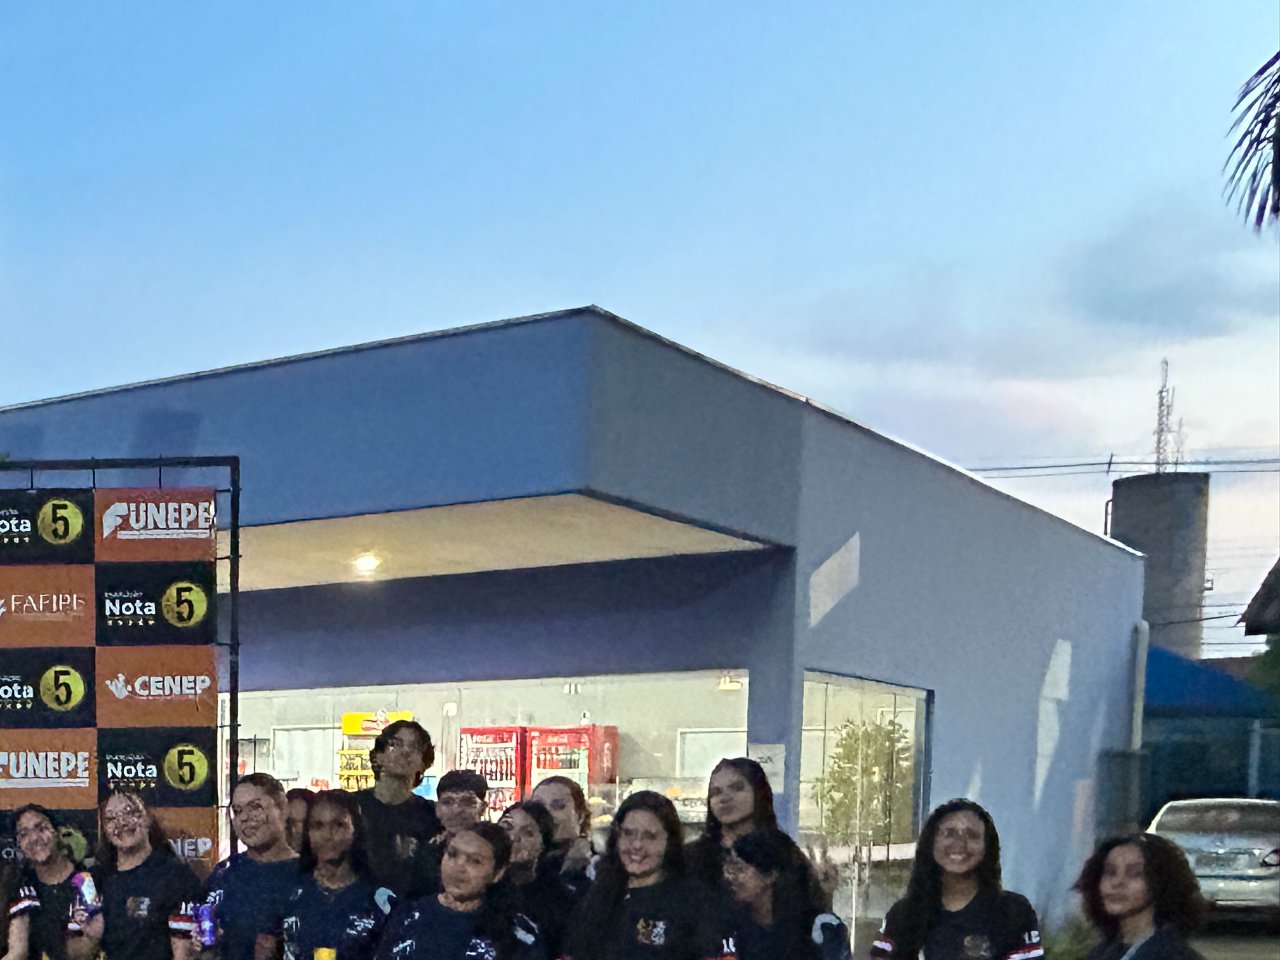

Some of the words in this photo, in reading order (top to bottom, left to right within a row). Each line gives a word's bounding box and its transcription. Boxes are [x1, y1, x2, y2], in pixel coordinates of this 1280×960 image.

[104, 599, 156, 616] Nota
[133, 674, 212, 696] CENEP
[106, 762, 158, 779] Nota
